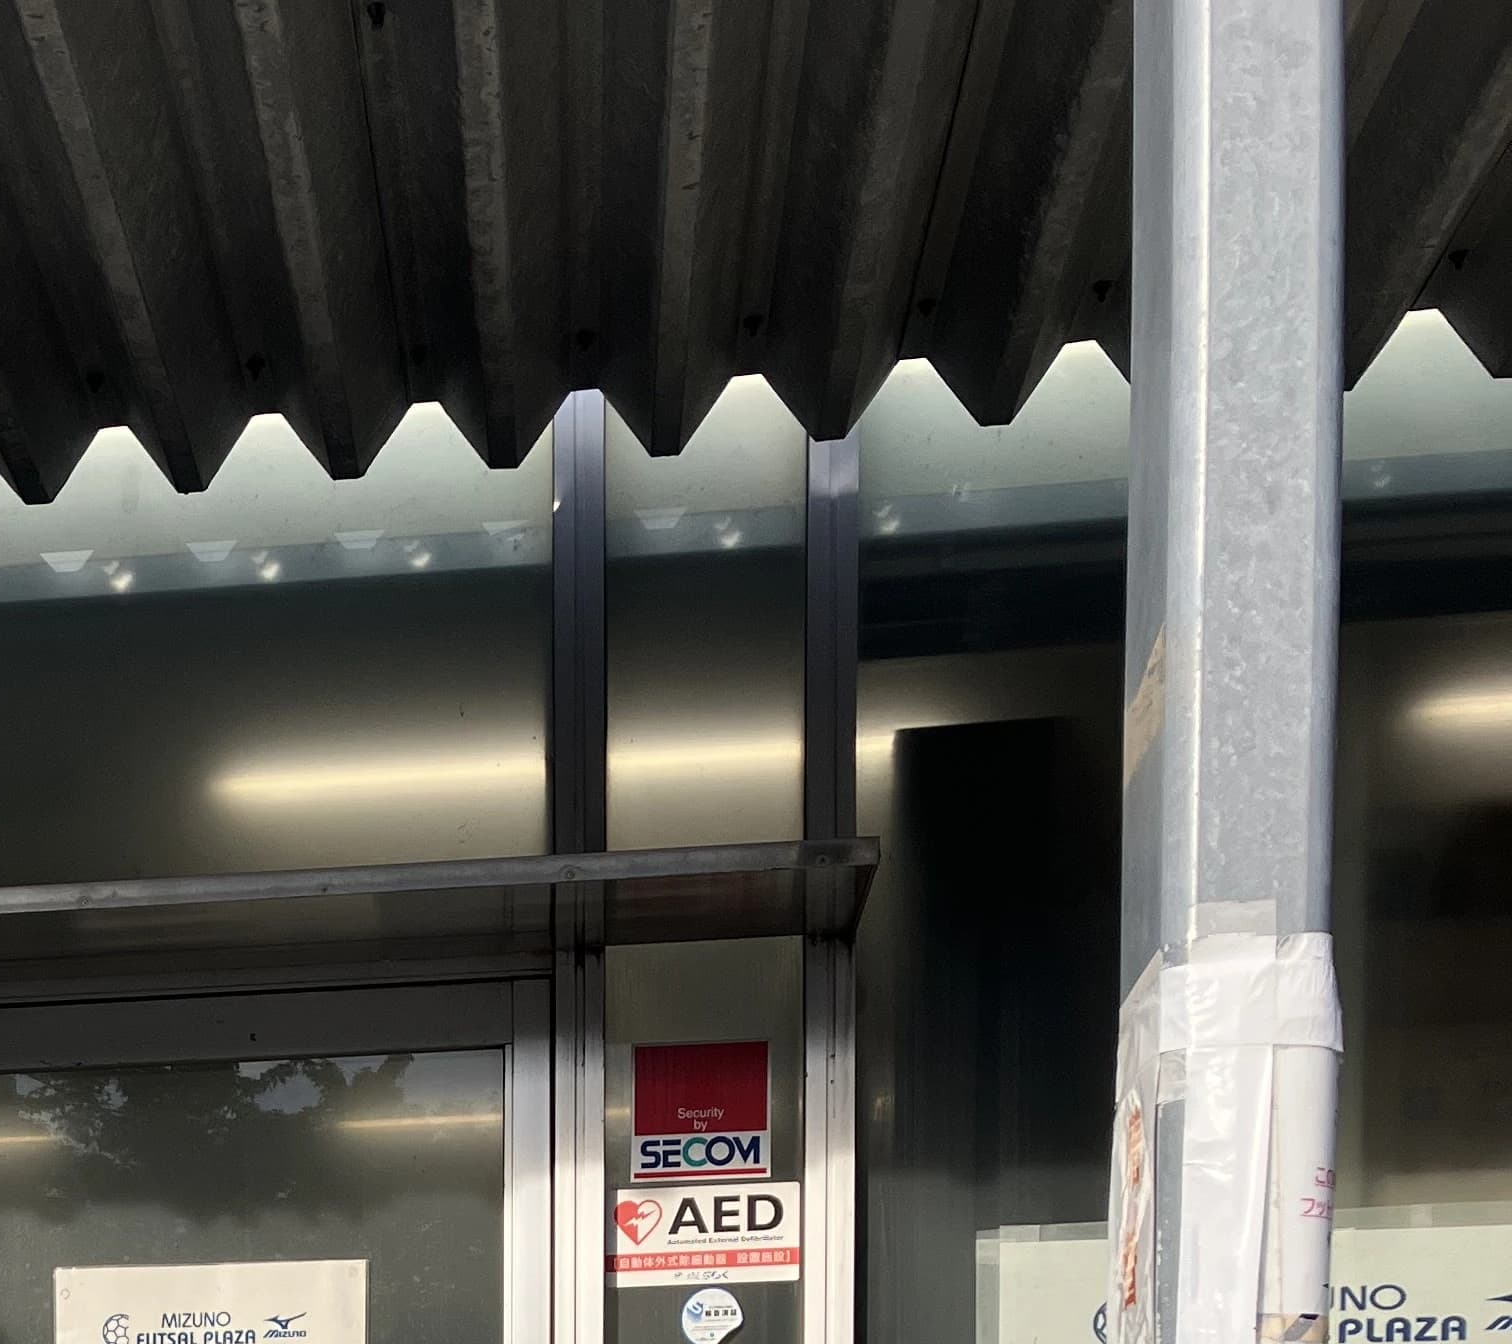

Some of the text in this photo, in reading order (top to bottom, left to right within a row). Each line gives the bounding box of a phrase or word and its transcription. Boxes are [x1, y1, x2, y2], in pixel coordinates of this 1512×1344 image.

[677, 1107, 725, 1120] Security
[693, 1119, 708, 1131] by
[640, 1135, 761, 1168] SECOM
[668, 1194, 784, 1235] AED
[161, 1311, 232, 1328] MIZUNO
[1338, 1316, 1467, 1343] PLAZA
